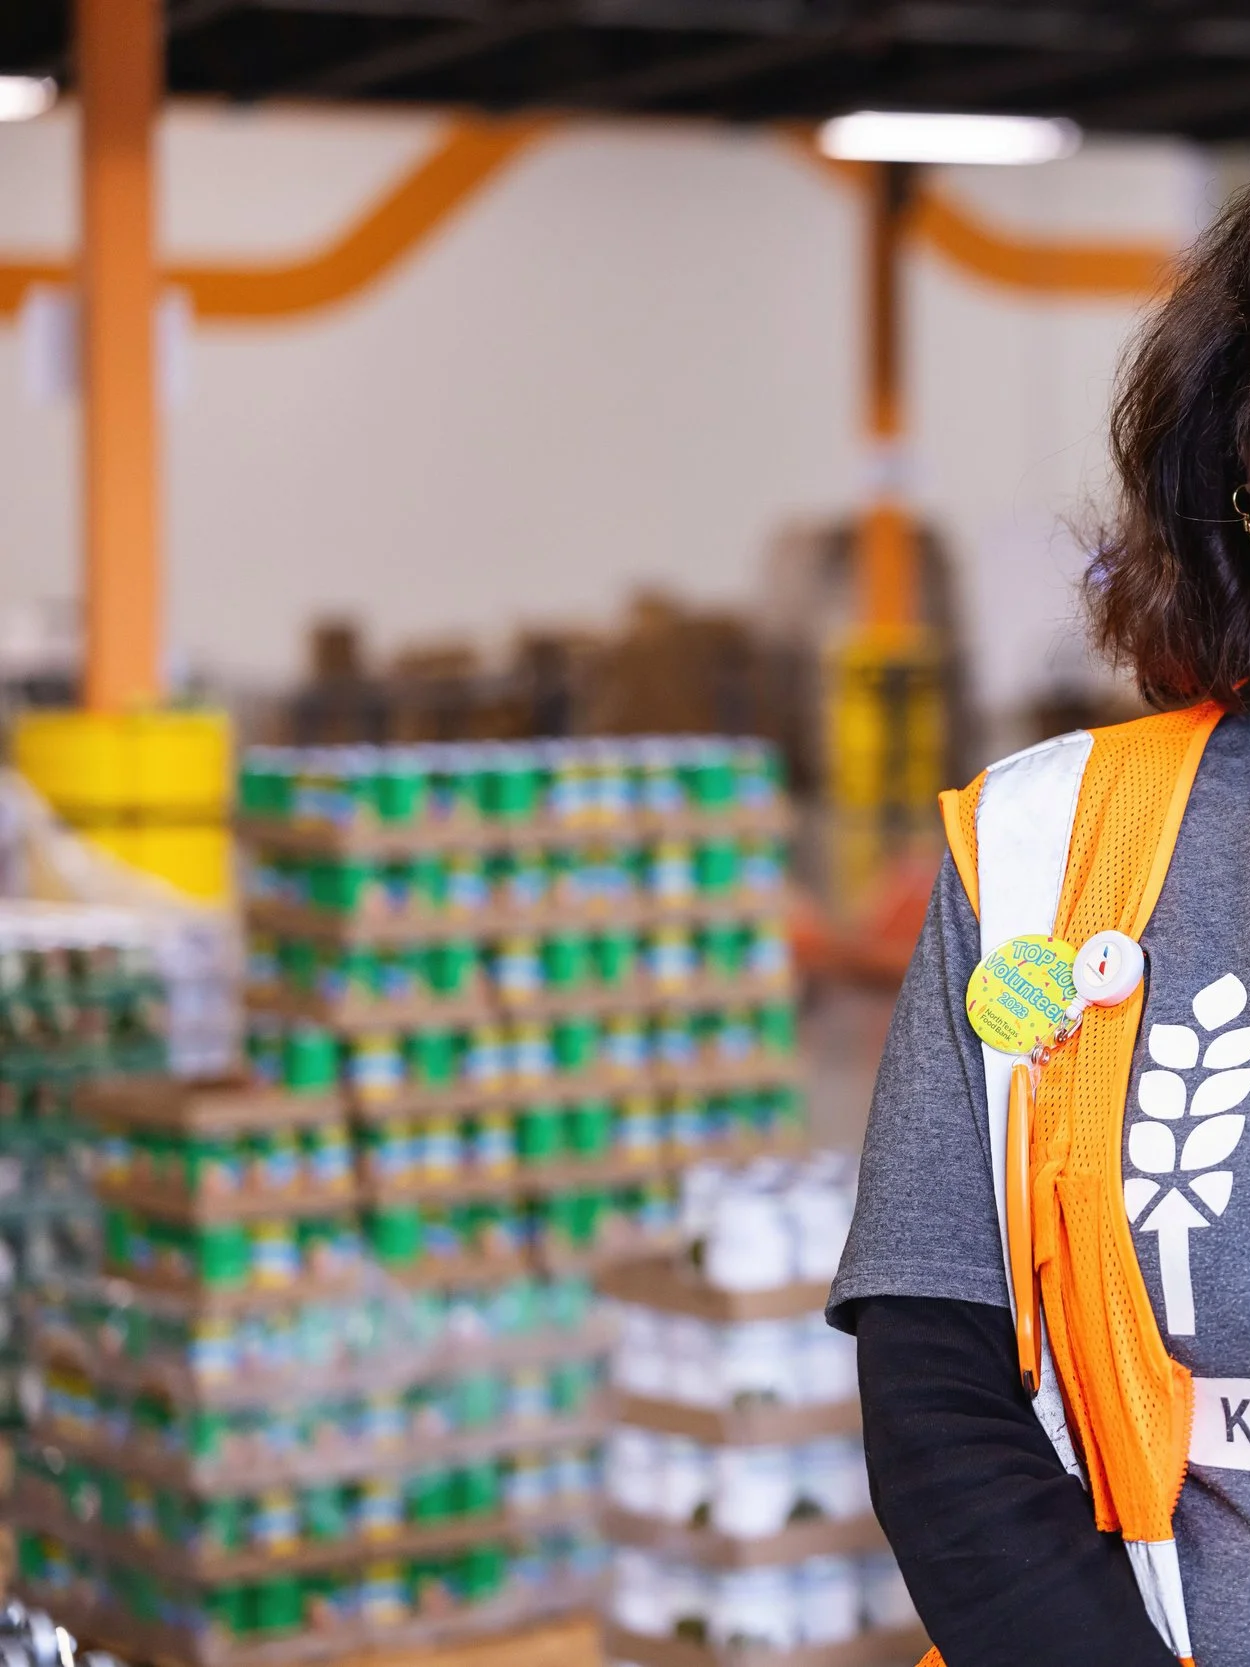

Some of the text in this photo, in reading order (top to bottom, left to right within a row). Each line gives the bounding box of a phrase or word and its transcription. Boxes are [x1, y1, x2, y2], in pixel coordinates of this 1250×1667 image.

[1012, 941, 1056, 966] TOP
[1048, 961, 1077, 1000] 100
[997, 992, 1029, 1019] 2023
[979, 1014, 1012, 1042] Food Bank
[984, 1008, 1019, 1038] North Texas
